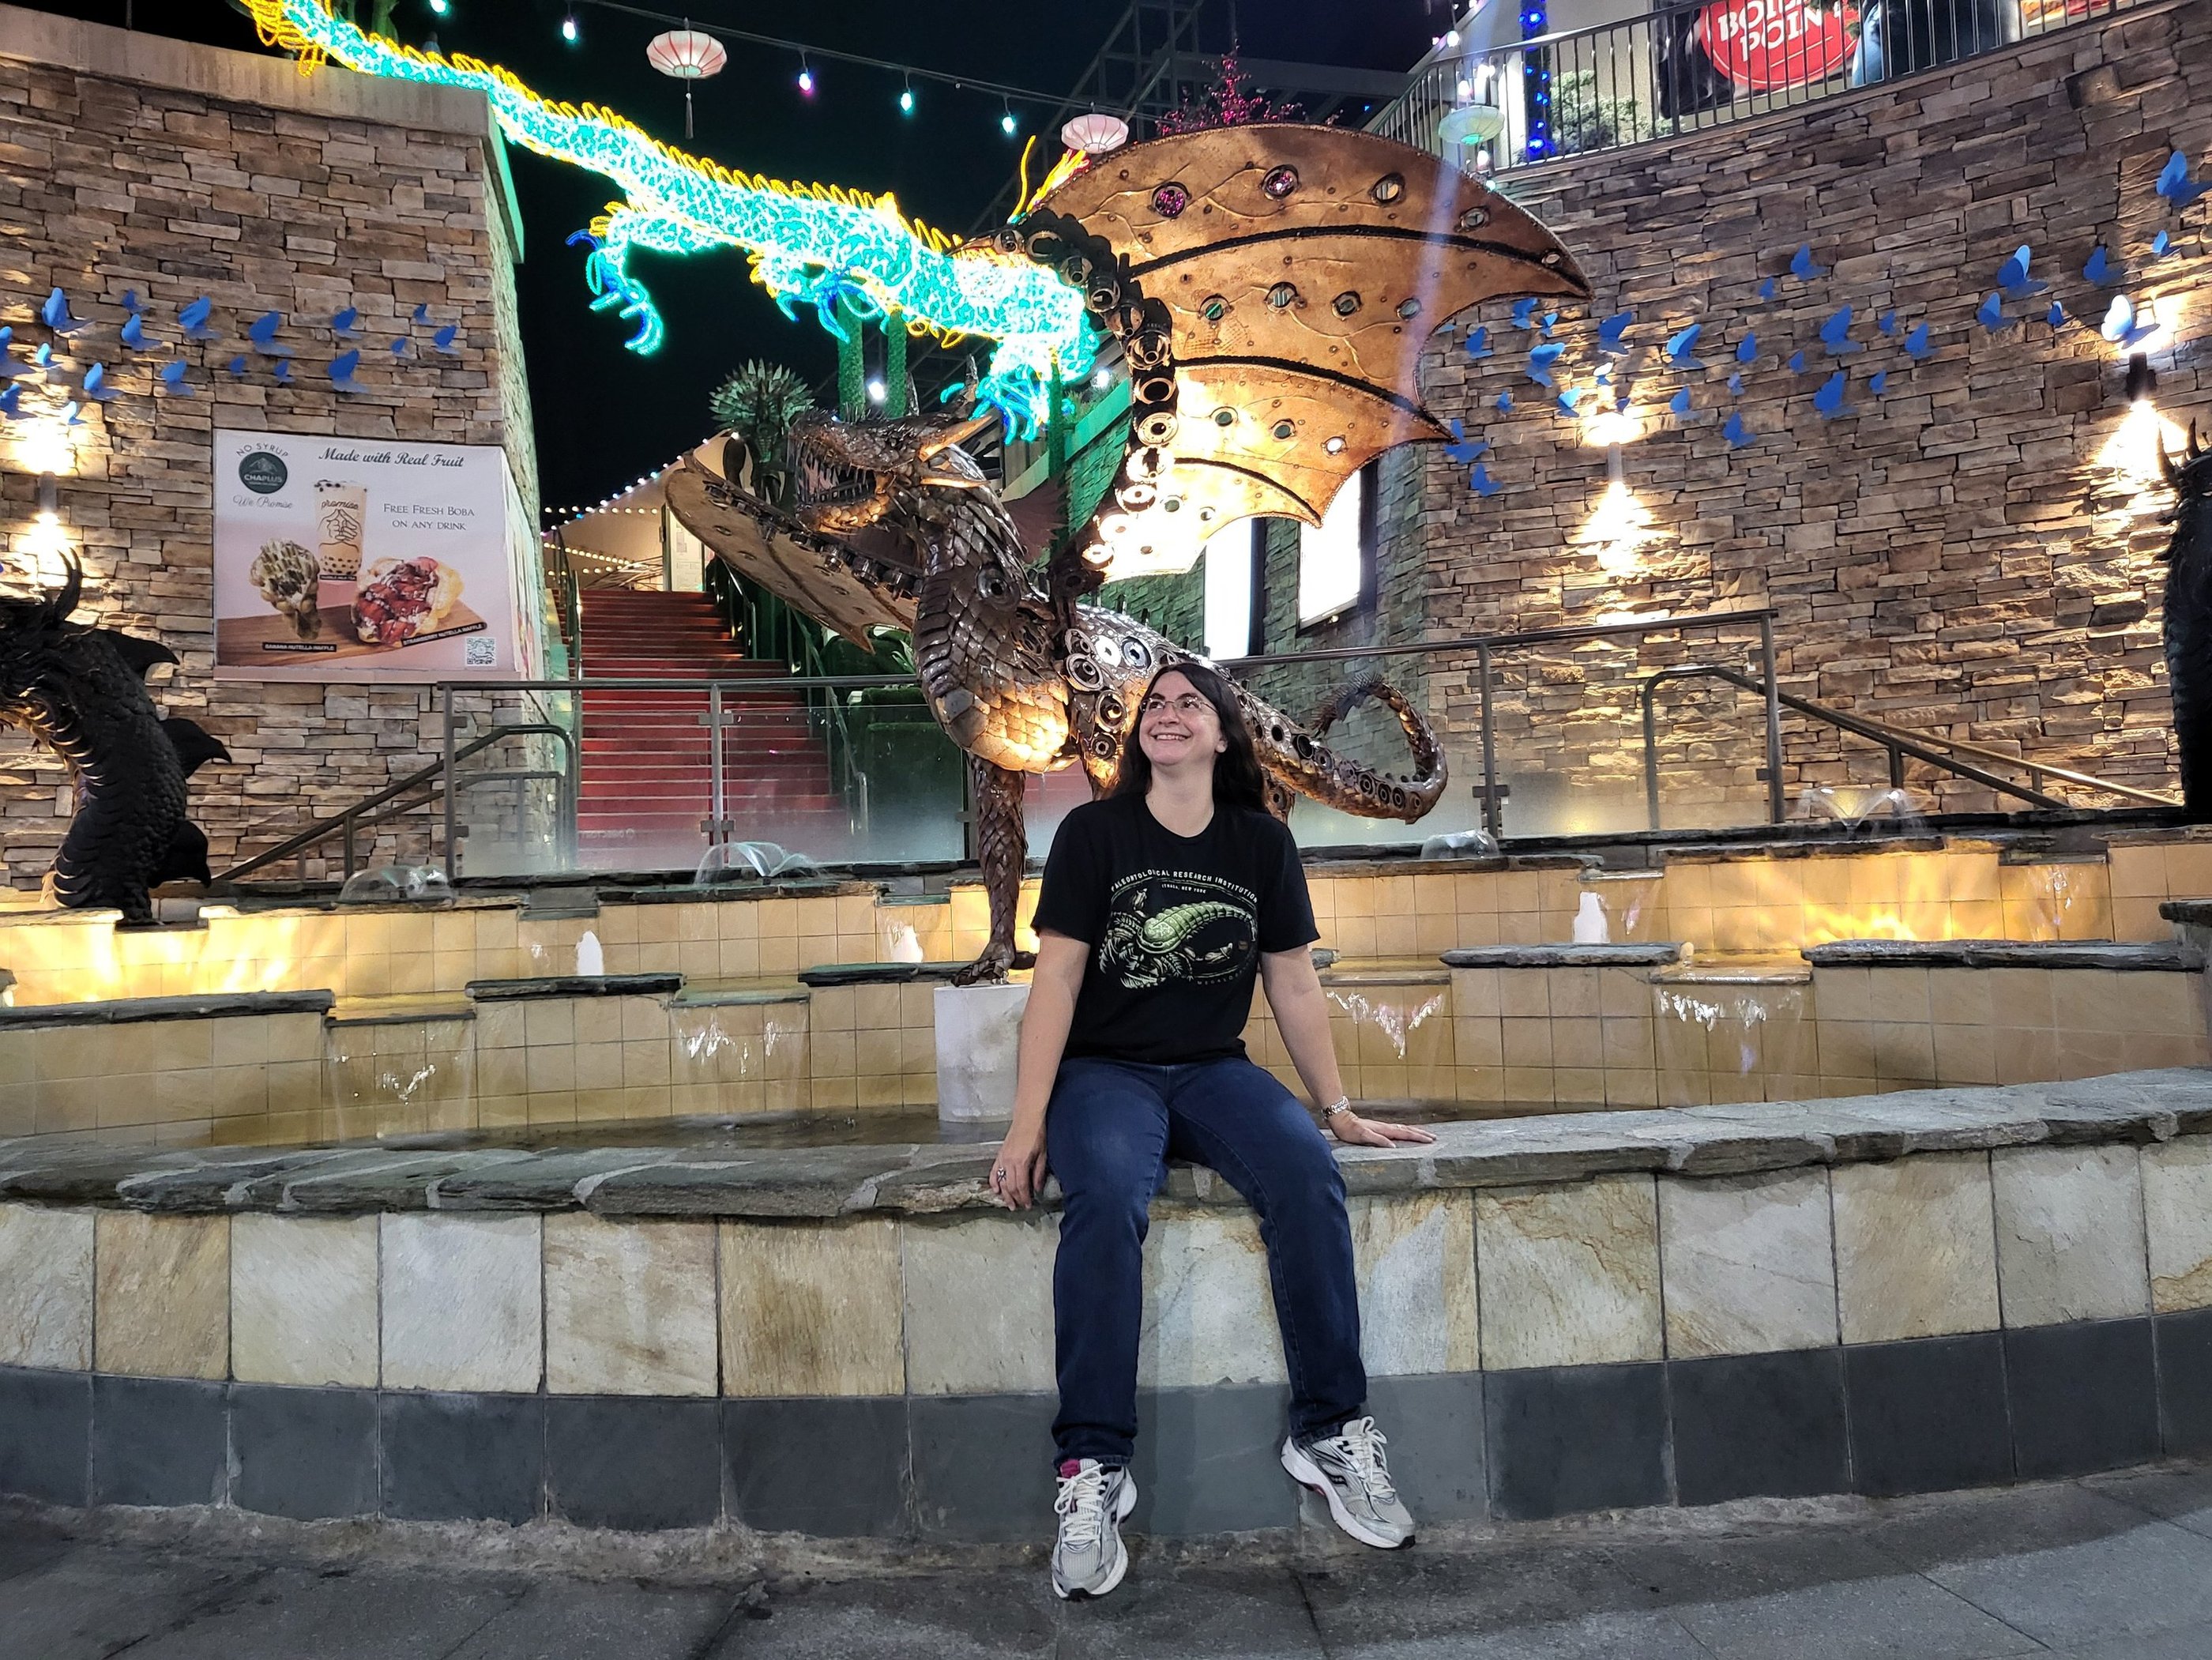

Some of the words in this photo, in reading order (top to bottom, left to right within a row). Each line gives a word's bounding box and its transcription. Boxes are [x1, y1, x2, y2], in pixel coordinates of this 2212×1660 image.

[236, 445, 252, 456] NO
[256, 442, 289, 457] SYRUP
[318, 447, 359, 462] Made
[363, 451, 391, 464] with
[395, 452, 429, 465] Real
[431, 454, 465, 468] Fruit
[1173, 871, 1213, 883] RESEARCH
[1214, 876, 1258, 904] INSTITUTION
